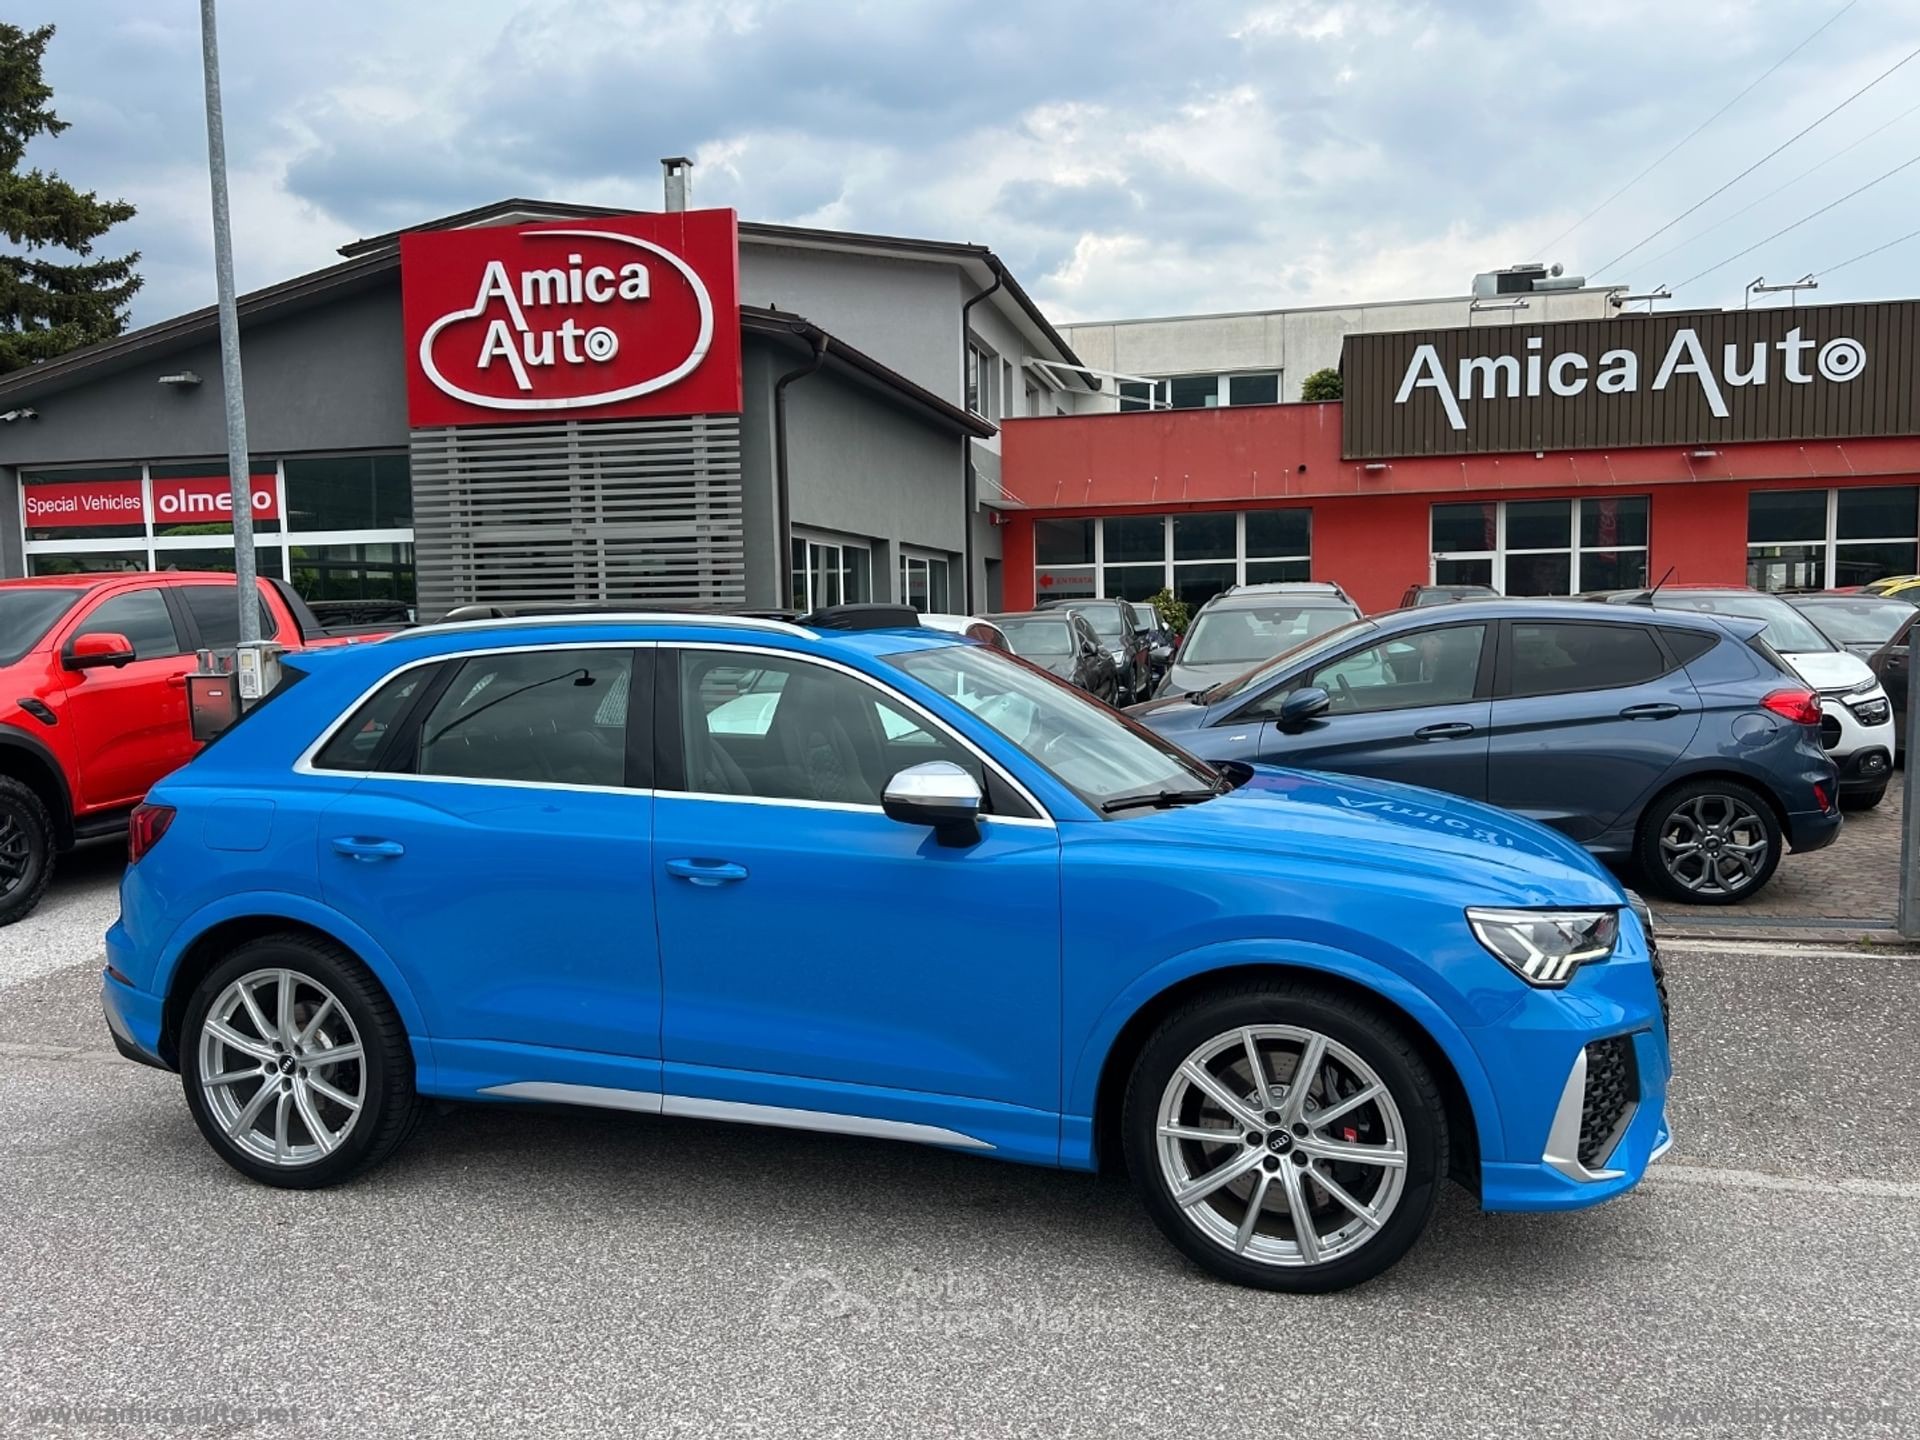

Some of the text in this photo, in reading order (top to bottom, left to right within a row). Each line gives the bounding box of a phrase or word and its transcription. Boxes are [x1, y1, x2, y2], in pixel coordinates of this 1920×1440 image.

[474, 253, 650, 332] Amica
[477, 318, 619, 390] Auto
[1395, 326, 1867, 430] Amica Auto
[27, 493, 142, 516] Special Vehicles
[158, 488, 272, 513] olmeo
